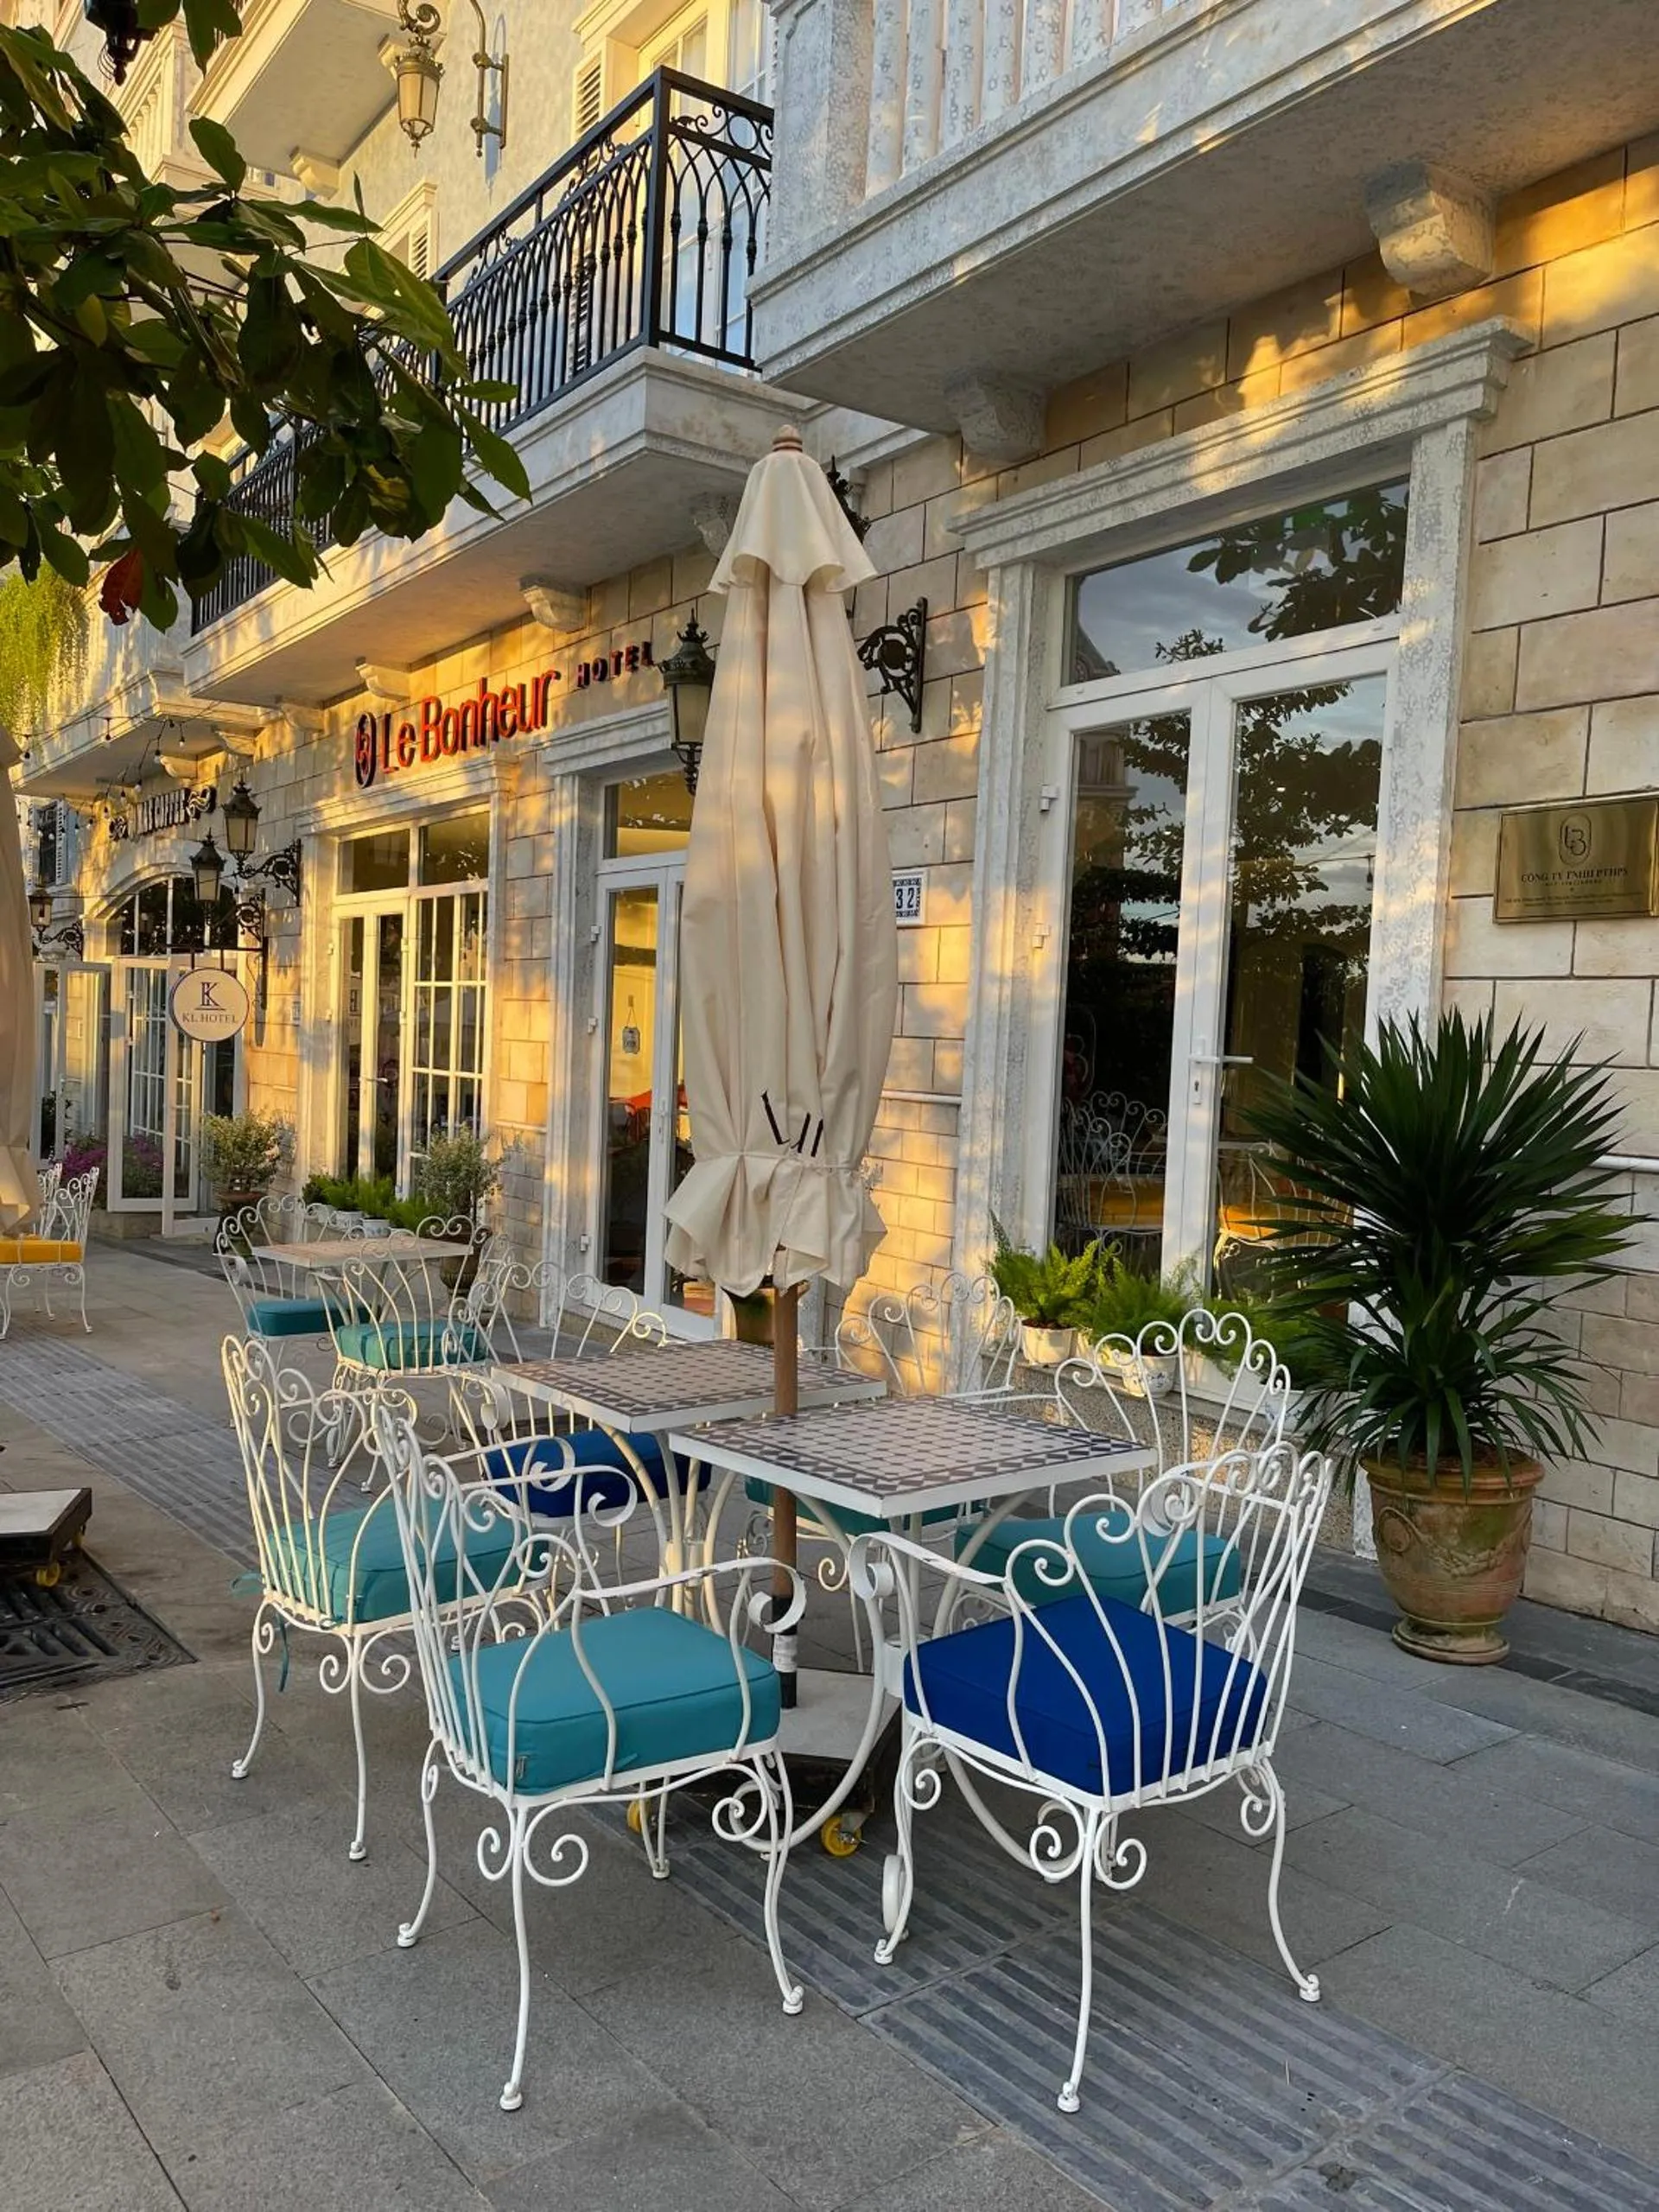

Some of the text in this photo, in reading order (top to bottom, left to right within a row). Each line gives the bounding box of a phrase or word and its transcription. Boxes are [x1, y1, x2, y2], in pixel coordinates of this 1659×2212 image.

[379, 713, 416, 774] Le
[420, 669, 562, 763] Bonheur
[576, 641, 654, 688] HOTEL
